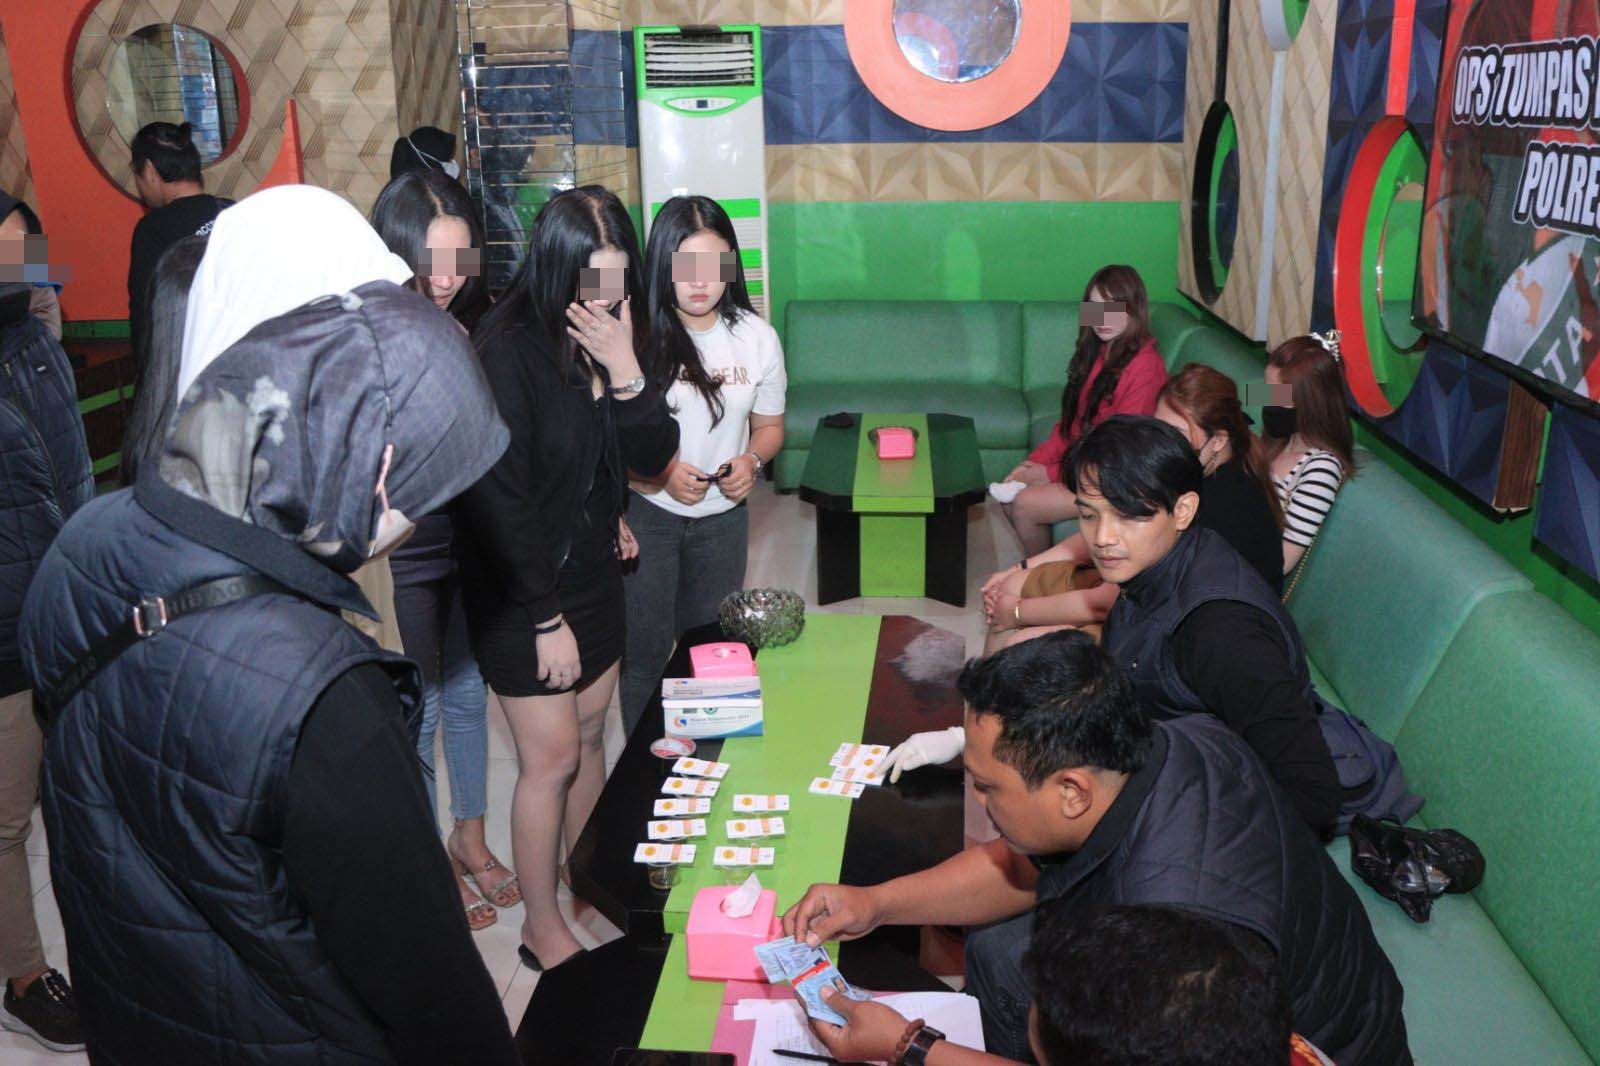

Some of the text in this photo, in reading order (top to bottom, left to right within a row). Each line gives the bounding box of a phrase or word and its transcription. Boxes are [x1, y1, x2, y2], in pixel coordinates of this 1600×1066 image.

[1454, 53, 1497, 116] OPS
[1495, 46, 1592, 120] TUMPAS
[1518, 150, 1600, 230] POLRE
